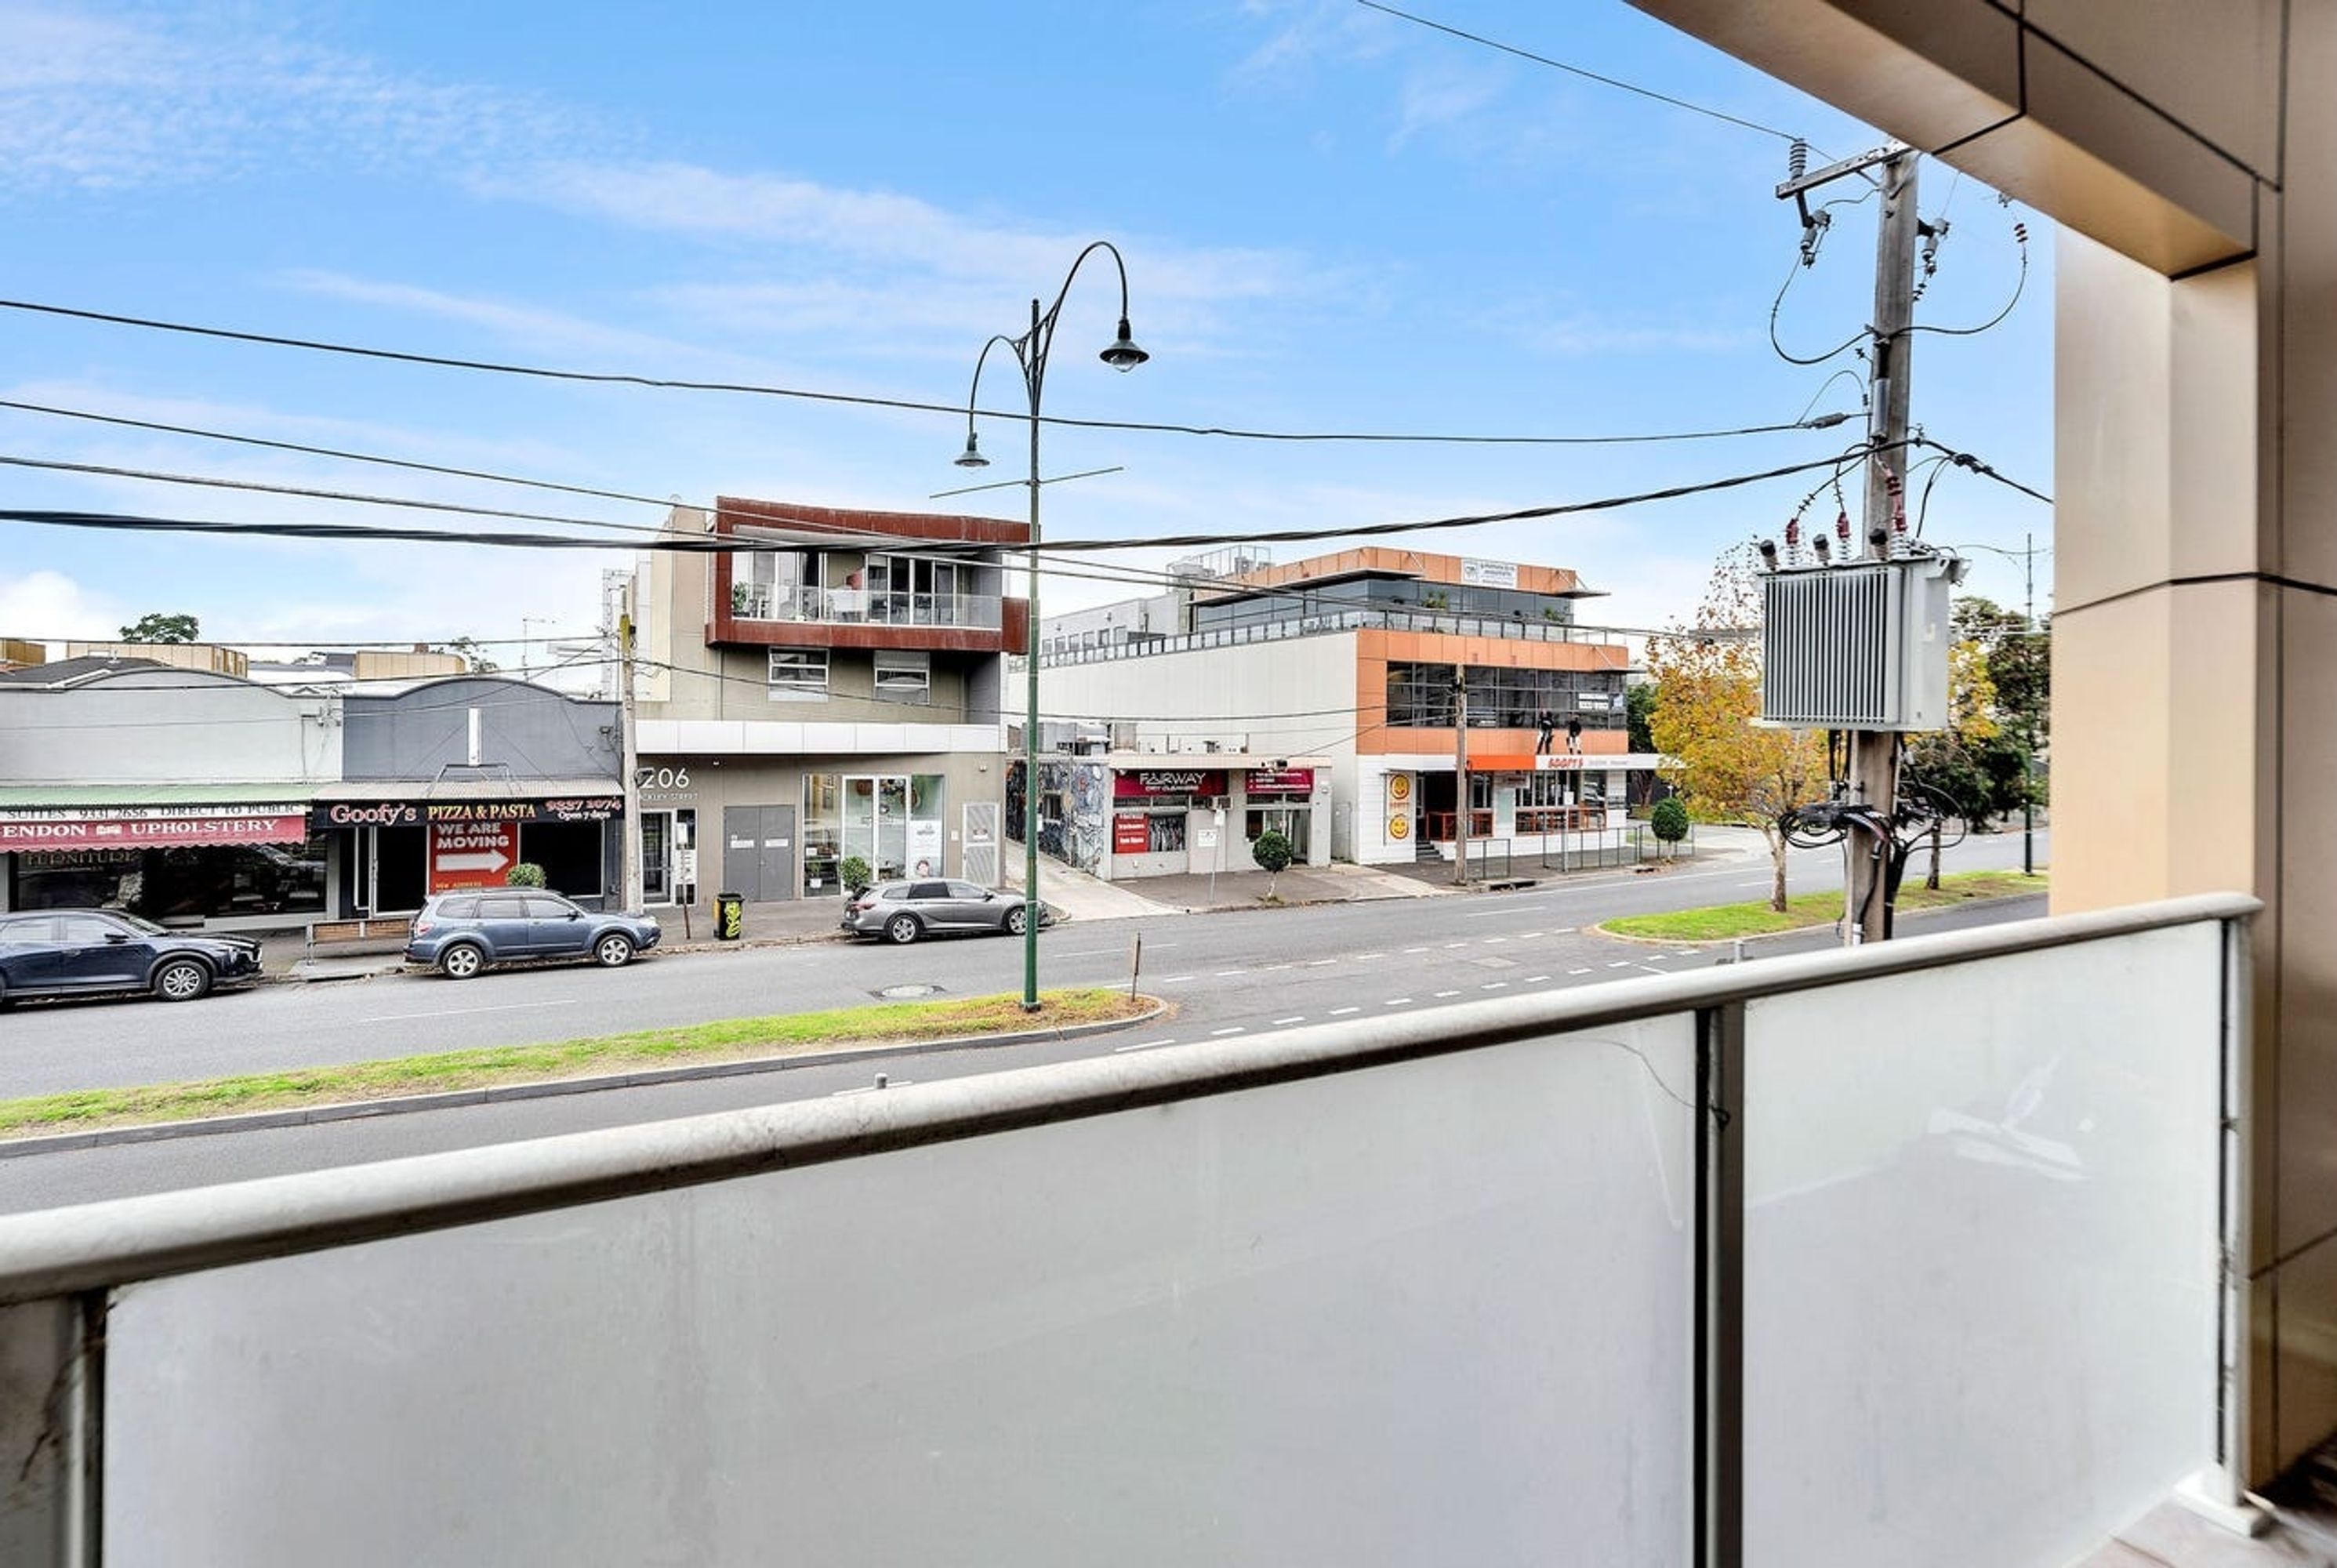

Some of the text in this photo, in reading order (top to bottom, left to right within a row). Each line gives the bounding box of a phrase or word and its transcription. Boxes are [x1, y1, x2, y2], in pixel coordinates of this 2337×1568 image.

[638, 768, 690, 789] 206
[1139, 772, 1207, 785] FAIRWAY
[7, 809, 67, 819] SUITES
[79, 808, 109, 819] 9331
[115, 808, 149, 818] 2656
[161, 806, 218, 816] DIRECT
[225, 805, 242, 815] TO
[330, 804, 417, 826] Goofy's
[427, 803, 536, 820] PIZZA & PASTA
[557, 811, 582, 821] Open
[582, 811, 590, 820] 7
[0, 819, 278, 838] ENDON UPHOLSTERY
[436, 822, 502, 835] WE ARE
[436, 835, 510, 849] MOVING
